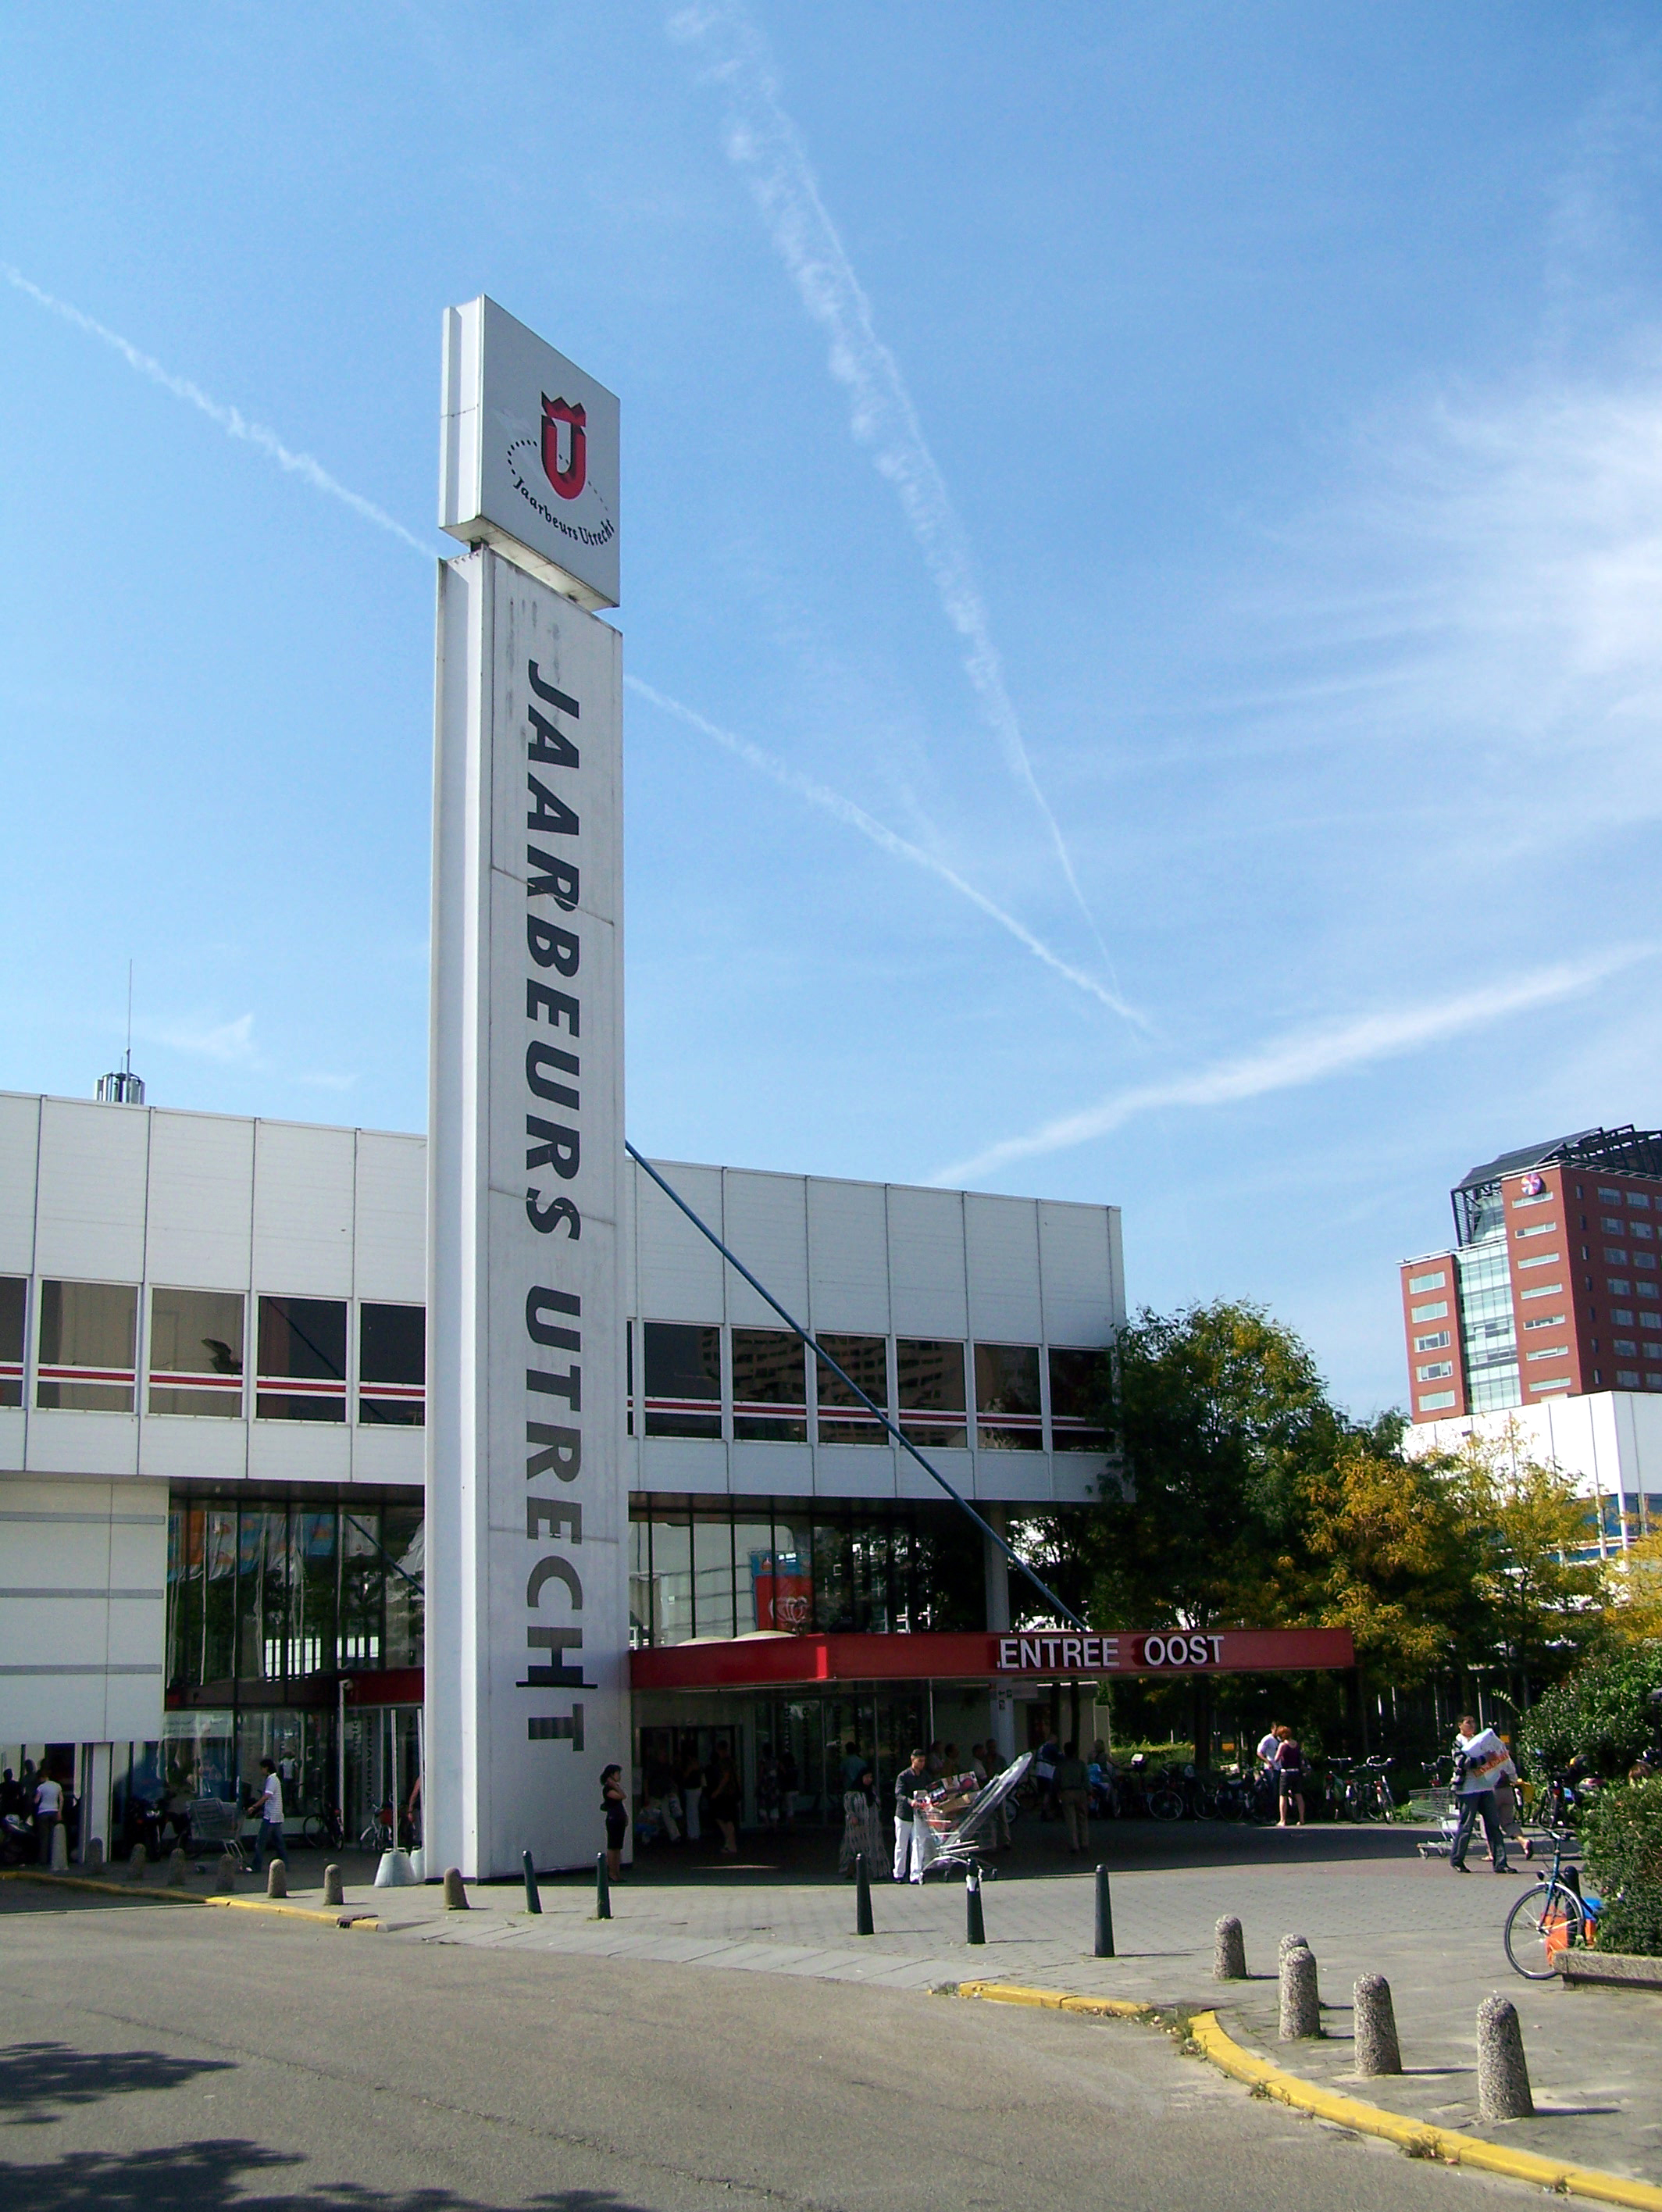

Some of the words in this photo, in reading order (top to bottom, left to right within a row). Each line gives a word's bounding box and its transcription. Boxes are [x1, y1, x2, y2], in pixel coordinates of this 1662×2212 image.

[513, 476, 579, 541] Jaarbeurs
[578, 519, 615, 546] Utrecht
[526, 658, 581, 1240] JAARBEURS
[525, 1285, 585, 1752] UTRECHT
[998, 1637, 1120, 1669] ENTREE
[1143, 1635, 1225, 1666] OOST
